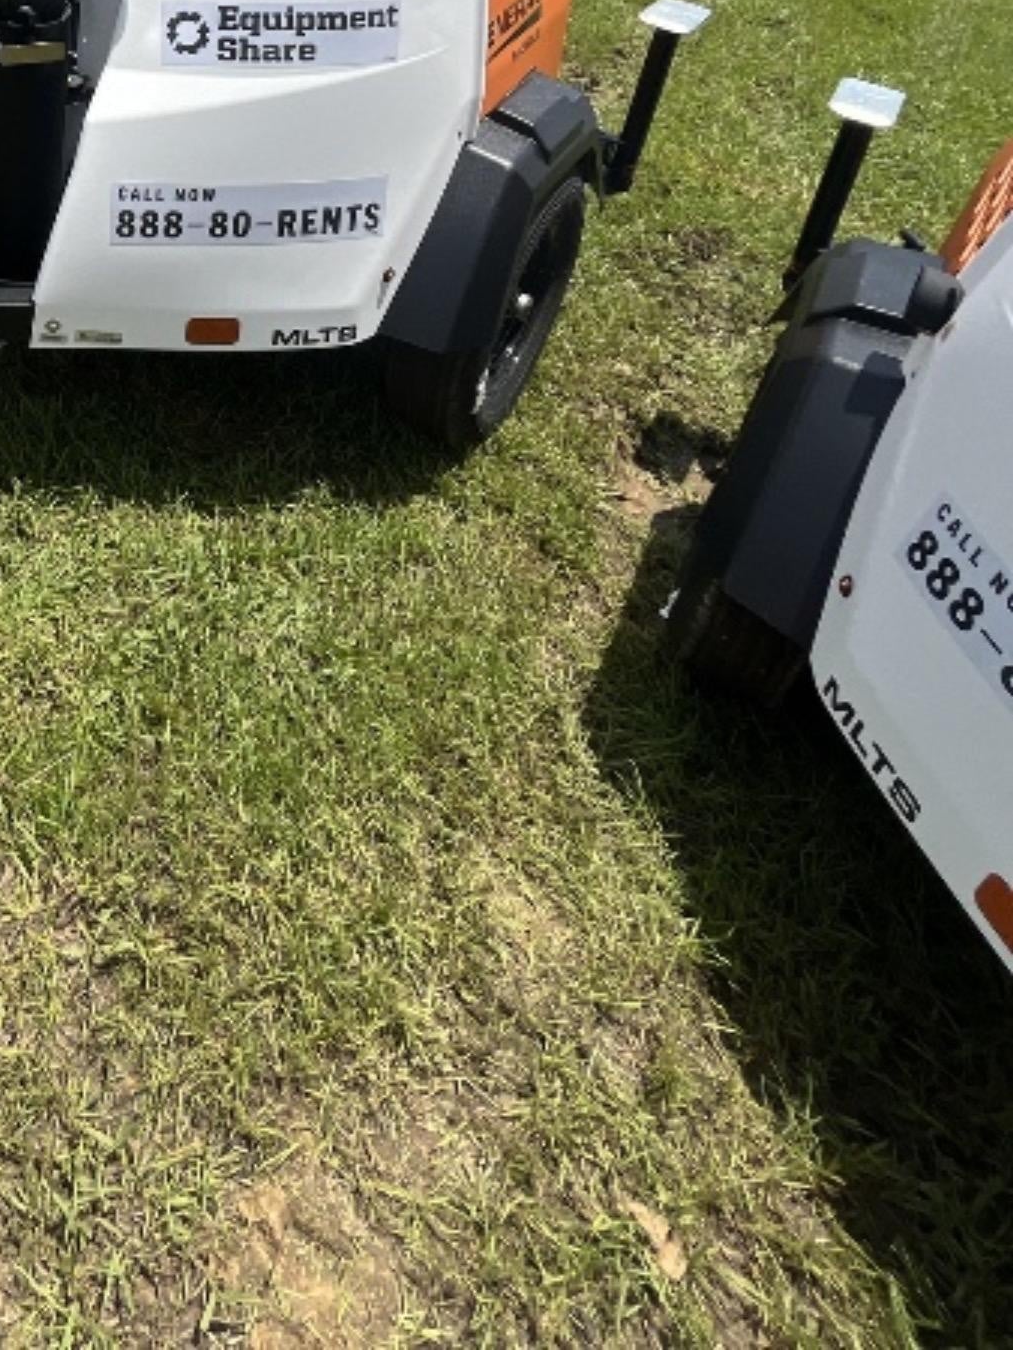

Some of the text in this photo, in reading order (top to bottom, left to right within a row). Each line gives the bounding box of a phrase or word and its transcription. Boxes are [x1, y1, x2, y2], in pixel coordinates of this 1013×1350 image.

[217, 4, 399, 36] Equipment
[217, 37, 316, 61] Share
[118, 186, 216, 202] CALL NOW
[115, 203, 381, 238] 888-80-RENTS
[937, 503, 984, 568] CALL
